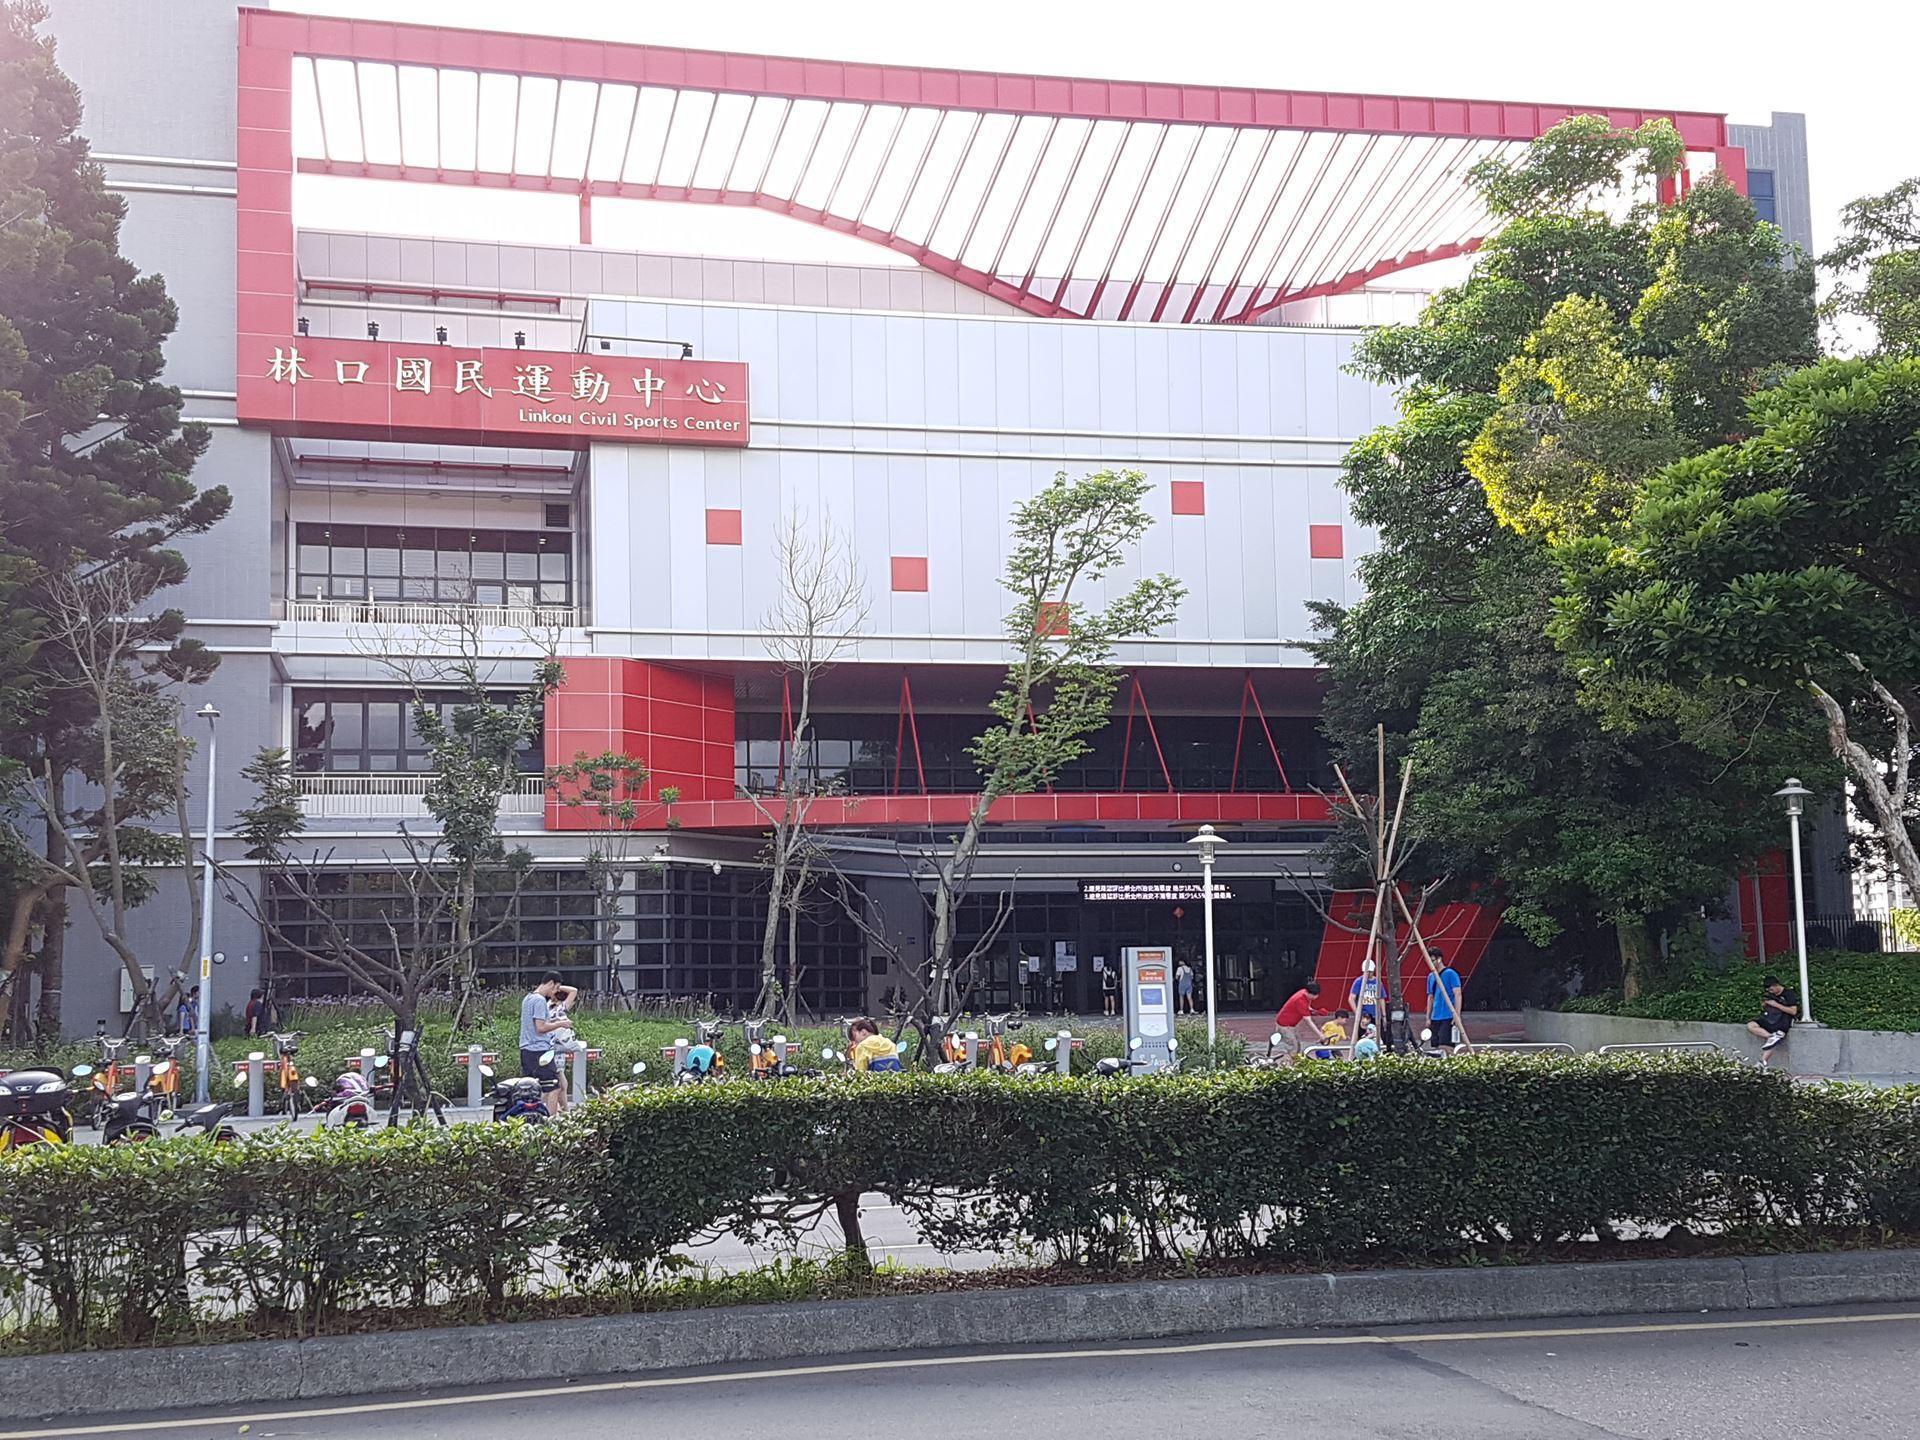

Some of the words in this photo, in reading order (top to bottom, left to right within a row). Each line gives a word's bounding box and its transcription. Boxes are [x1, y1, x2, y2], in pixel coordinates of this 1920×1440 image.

[266, 346, 727, 408] 林口國民運動中心
[519, 408, 572, 424] Linkou
[579, 411, 617, 426] Civil
[623, 413, 678, 430] Sports
[684, 417, 741, 432] Center
